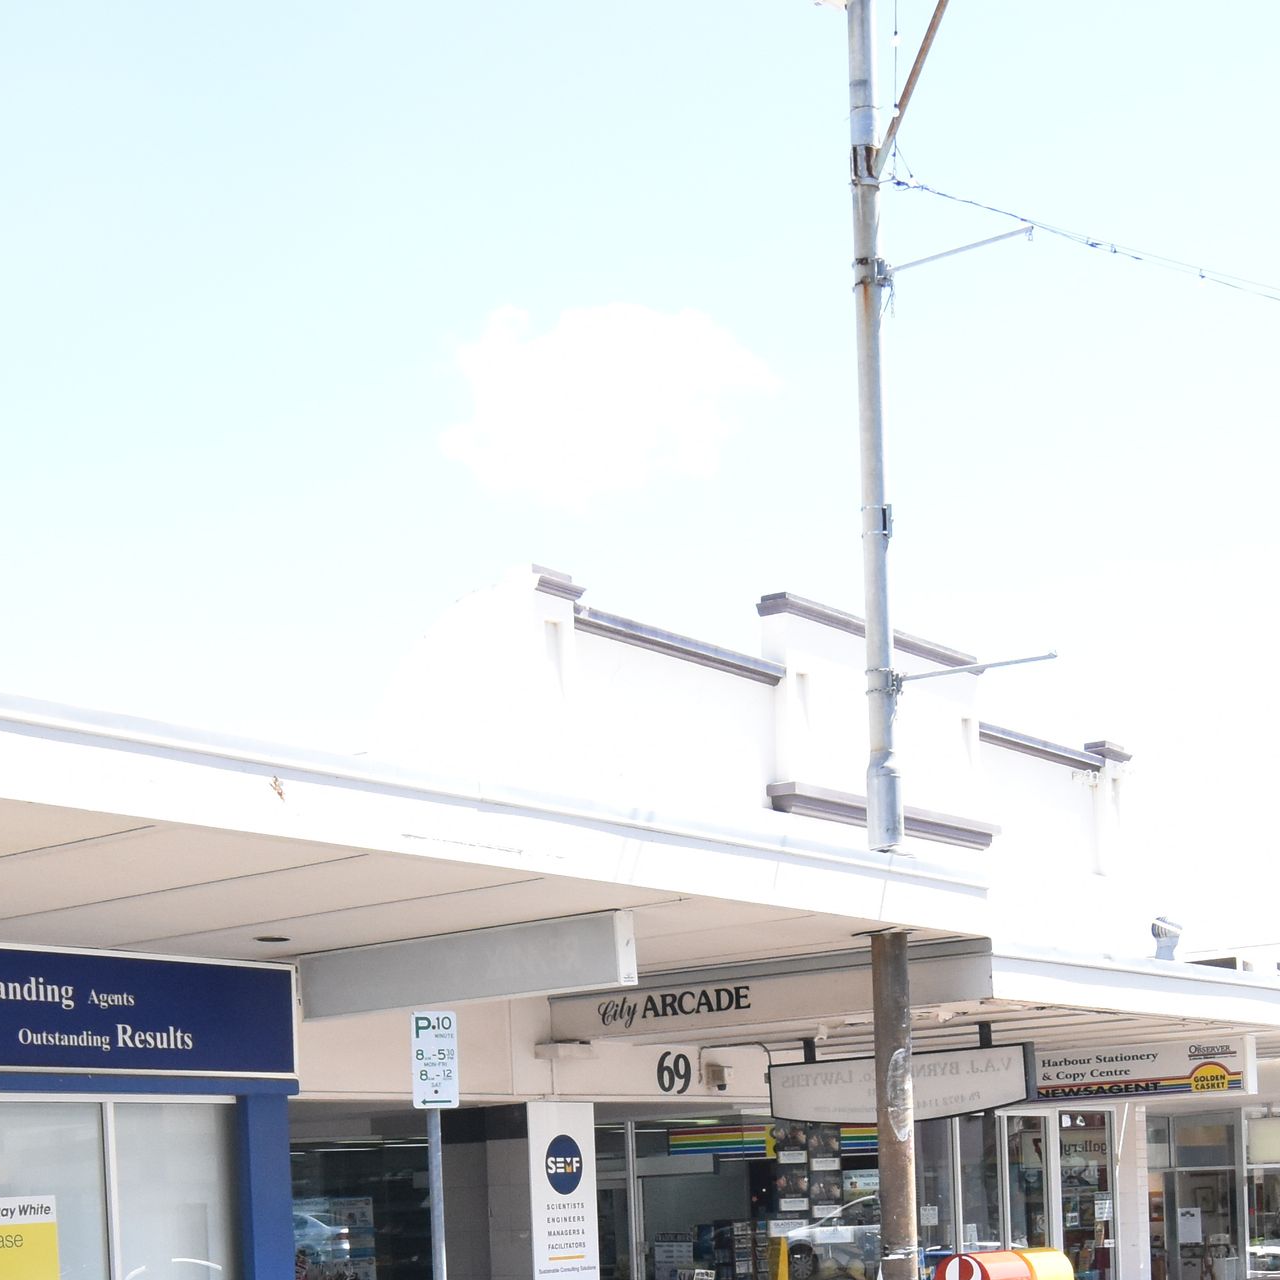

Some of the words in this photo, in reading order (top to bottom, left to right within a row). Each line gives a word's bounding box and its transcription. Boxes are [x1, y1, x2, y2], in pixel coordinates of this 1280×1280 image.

[88, 989, 135, 1009] Agents
[598, 997, 638, 1028] City
[642, 986, 751, 1019] ARCADE
[415, 1016, 431, 1038] P
[18, 1028, 111, 1051] Outstanding
[115, 1024, 193, 1050] Results
[1041, 1057, 1092, 1068] Harbour
[1095, 1052, 1159, 1064] Stationery
[657, 1051, 691, 1094] 69
[1042, 1072, 1052, 1080] &
[1056, 1070, 1087, 1082] Copy
[1090, 1067, 1131, 1078] Centre
[1194, 1074, 1226, 1083] GOLDEN
[1037, 1081, 1161, 1099] NEWSAGENT
[1195, 1082, 1225, 1090] CASKET
[547, 1157, 581, 1174] SEMF
[18, 1203, 51, 1217] White
[547, 1216, 585, 1224] ENGINEERS
[547, 1229, 580, 1237] MANAGERS
[548, 1242, 586, 1250] FACILITATORS
